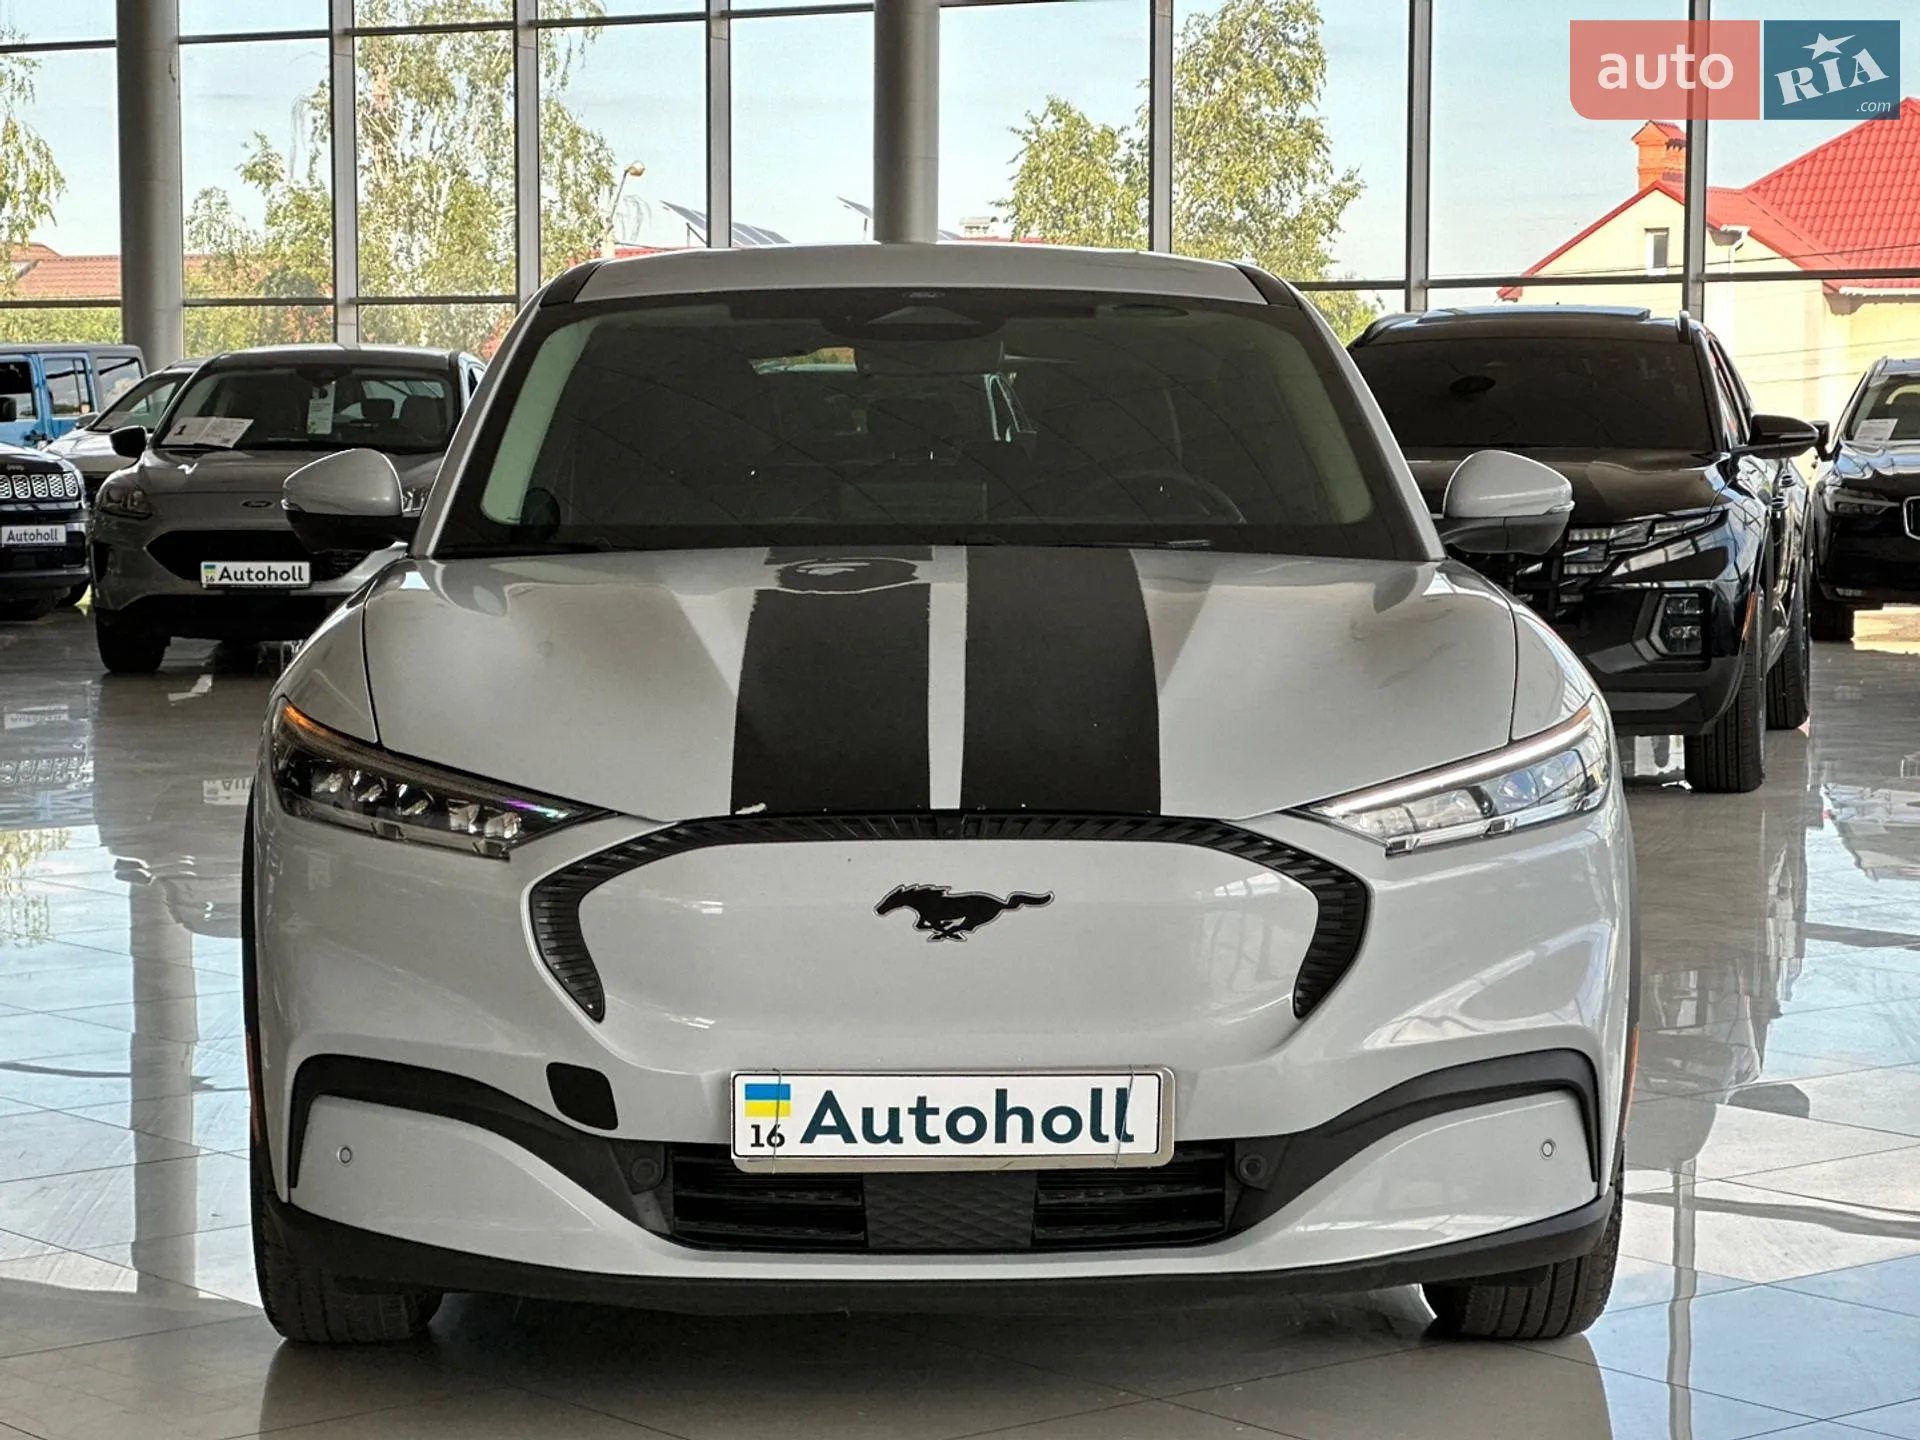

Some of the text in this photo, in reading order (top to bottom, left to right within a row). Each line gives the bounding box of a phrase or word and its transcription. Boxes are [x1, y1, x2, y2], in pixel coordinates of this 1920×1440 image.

[6, 528, 58, 542] Autoholl
[218, 564, 304, 582] Autoholl
[749, 1087, 1135, 1149] 16 Autoholl
